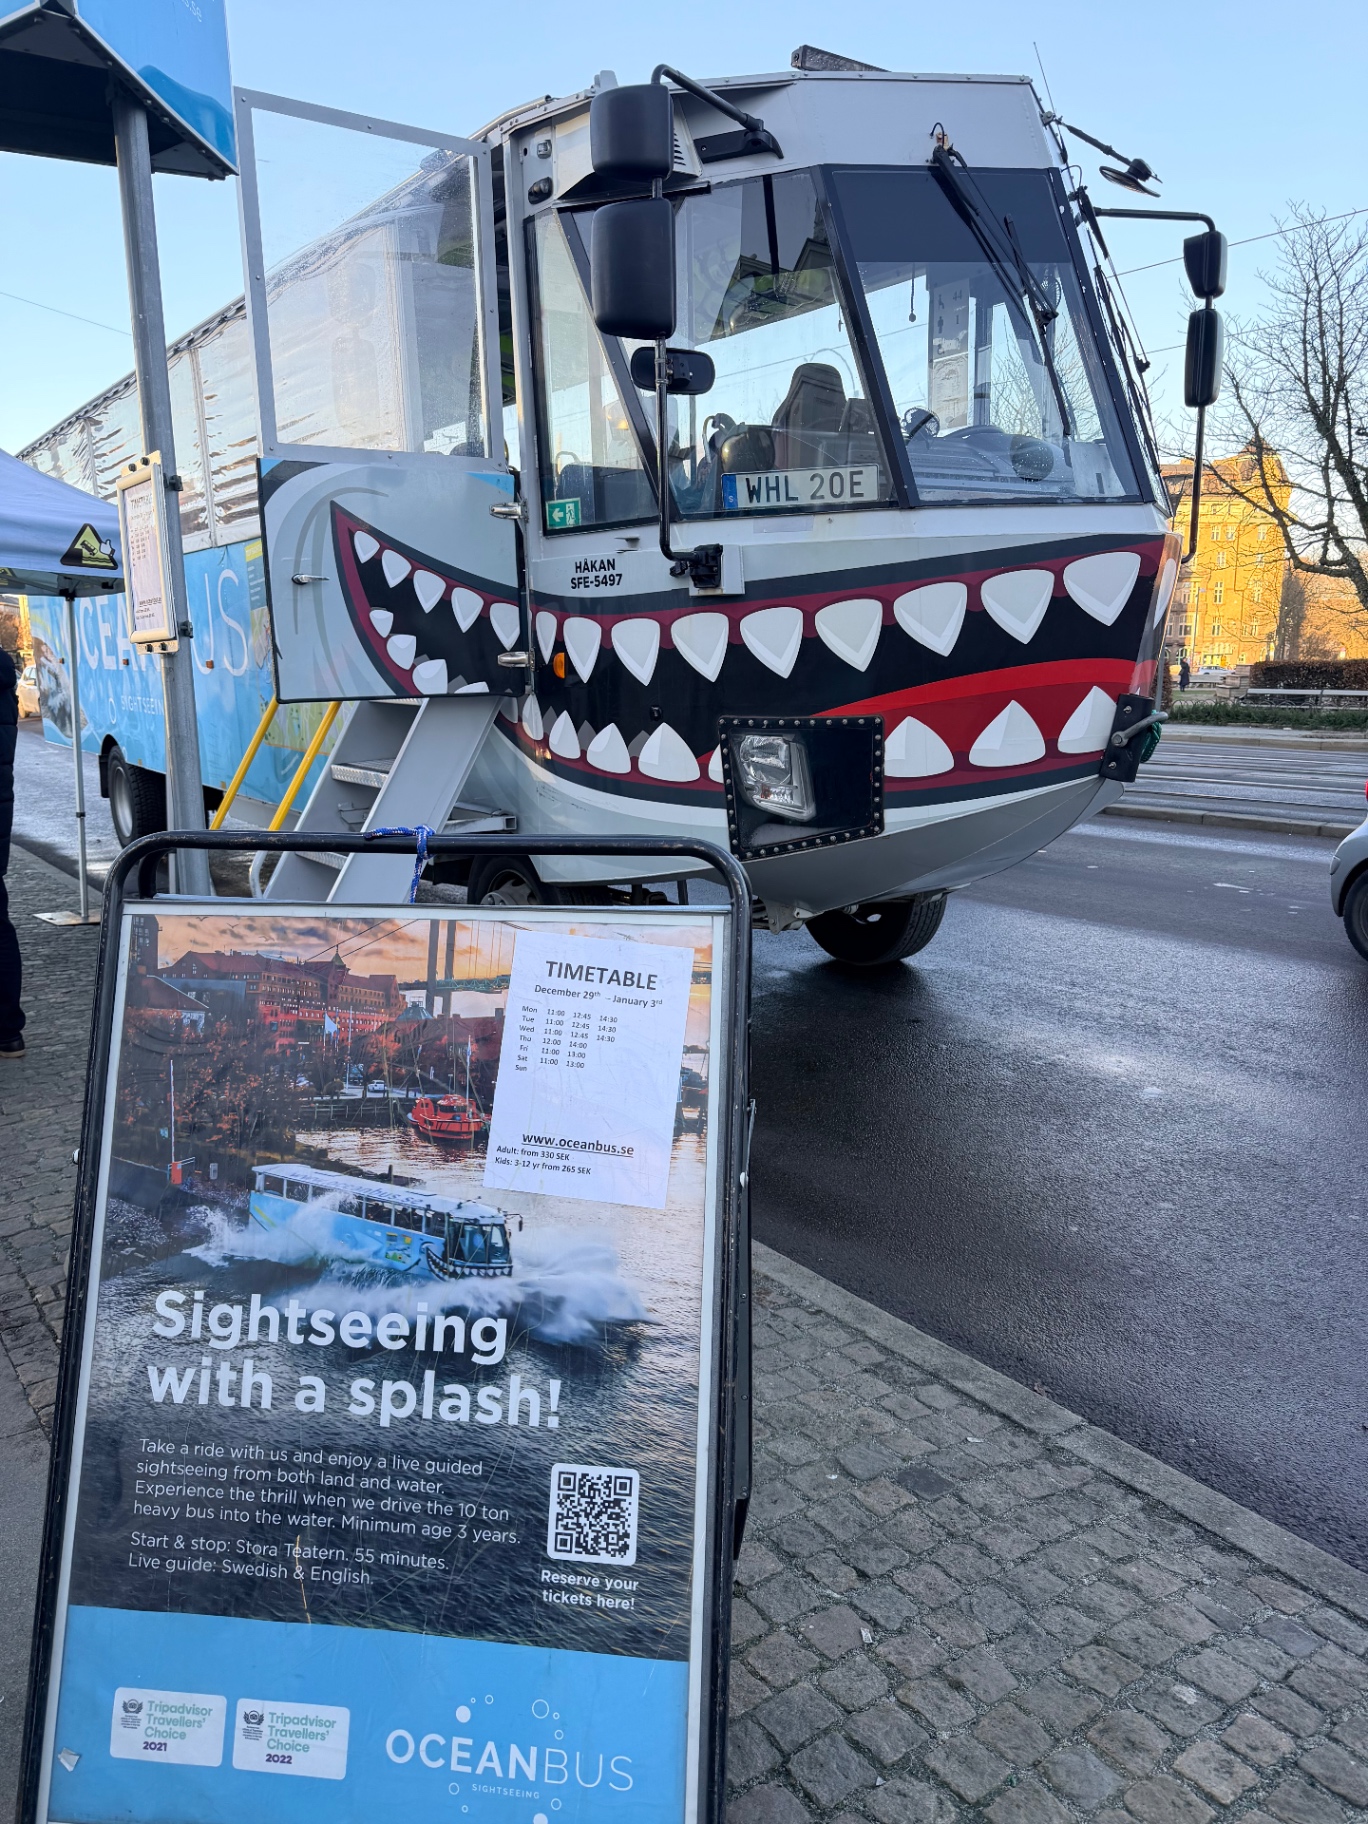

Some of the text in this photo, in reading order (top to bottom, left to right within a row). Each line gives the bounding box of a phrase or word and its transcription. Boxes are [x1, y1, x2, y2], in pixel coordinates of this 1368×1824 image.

[745, 470, 864, 503] WHL 20E
[728, 495, 734, 503] S
[575, 558, 616, 573] HÅKAN
[571, 573, 623, 589] SFE-5497
[121, 695, 164, 715] SIGHTSEEIN
[546, 960, 658, 990] TIMETABLE
[534, 984, 580, 998] December
[612, 995, 648, 1008] January
[522, 1005, 618, 1023] Mon 11:00 12:45 14:30
[522, 1015, 616, 1033] Tue 11:00 12:45 14:30
[544, 1028, 562, 1036] 11:00
[570, 1031, 588, 1039] 12:45
[541, 1047, 560, 1055] 11:00
[567, 1051, 586, 1059] 13:00
[569, 1041, 587, 1049] 14:00
[515, 1064, 527, 1072] Sun
[539, 1057, 558, 1066] 11:00
[566, 1060, 585, 1068] 13:00
[496, 1145, 570, 1161] Adult: from 330 SEK
[522, 1133, 635, 1157] www.oceanbus.se
[495, 1156, 592, 1175] Kids: 3-12 yr from 265 SEK
[152, 1289, 508, 1366] Sightseeing
[147, 1357, 562, 1429] with a splash!
[140, 1438, 483, 1476] Take a ride with us and enjoy a live guided
[136, 1459, 445, 1494] sightseeing from both land and water.
[135, 1480, 509, 1521] Experience the thrill when we drive the 10 ton
[133, 1500, 521, 1544] heavy bus into the water. Minimum age 3 years.
[130, 1531, 449, 1570] Start & stop: Stora Teatern. 55 minutes.
[128, 1552, 374, 1585] Live guide: Swedish & English.
[541, 1569, 639, 1591] Reserve your
[542, 1589, 635, 1610] tickets here!
[147, 1700, 213, 1717] Tripadvisor
[268, 1712, 336, 1729] Tripadvisor
[144, 1726, 187, 1740] Choice
[142, 1741, 168, 1752] 2021
[266, 1738, 310, 1753] Choice
[265, 1753, 293, 1764] 2022
[385, 1729, 634, 1791] OCEANBUS
[472, 1783, 540, 1799] SIGHTSEEING
